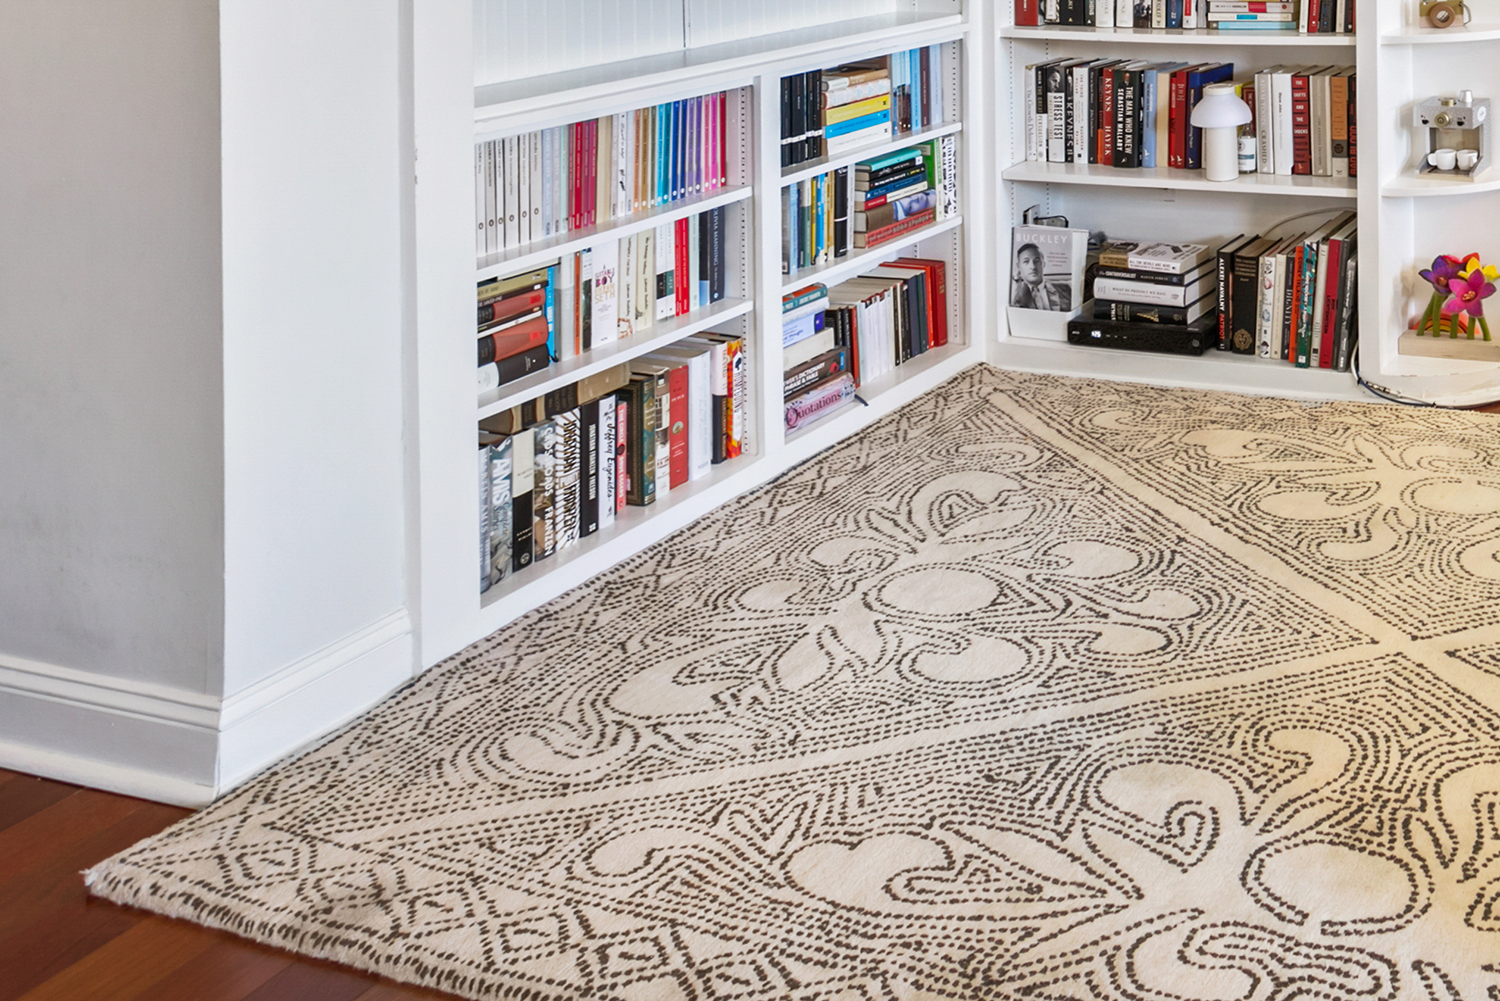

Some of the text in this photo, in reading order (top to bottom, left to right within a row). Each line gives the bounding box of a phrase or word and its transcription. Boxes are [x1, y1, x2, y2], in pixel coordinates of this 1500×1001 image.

[1053, 95, 1063, 140] STRESS TEST
[1104, 78, 1112, 156] KEYNES HAYEK
[1124, 86, 1133, 154] THE MAN WHO KNEW
[1116, 123, 1124, 152] MALLABY
[892, 214, 930, 233] NORA EPHRON
[1015, 232, 1068, 244] BUCKLEY
[594, 292, 615, 304] SETH
[595, 275, 614, 288] BOY
[1284, 288, 1293, 325] DIGNITY
[1322, 295, 1332, 334] LICHTENSTEIN
[799, 362, 826, 379] DICTIONARY
[734, 371, 743, 413] HOMEGOING
[786, 391, 842, 430] Quotations
[563, 419, 577, 534] JONATHAN FRANZEN
[602, 423, 615, 498] Jeffrey Eugenides
[492, 457, 511, 507] AMIS
[543, 506, 554, 557] FRANZEN
